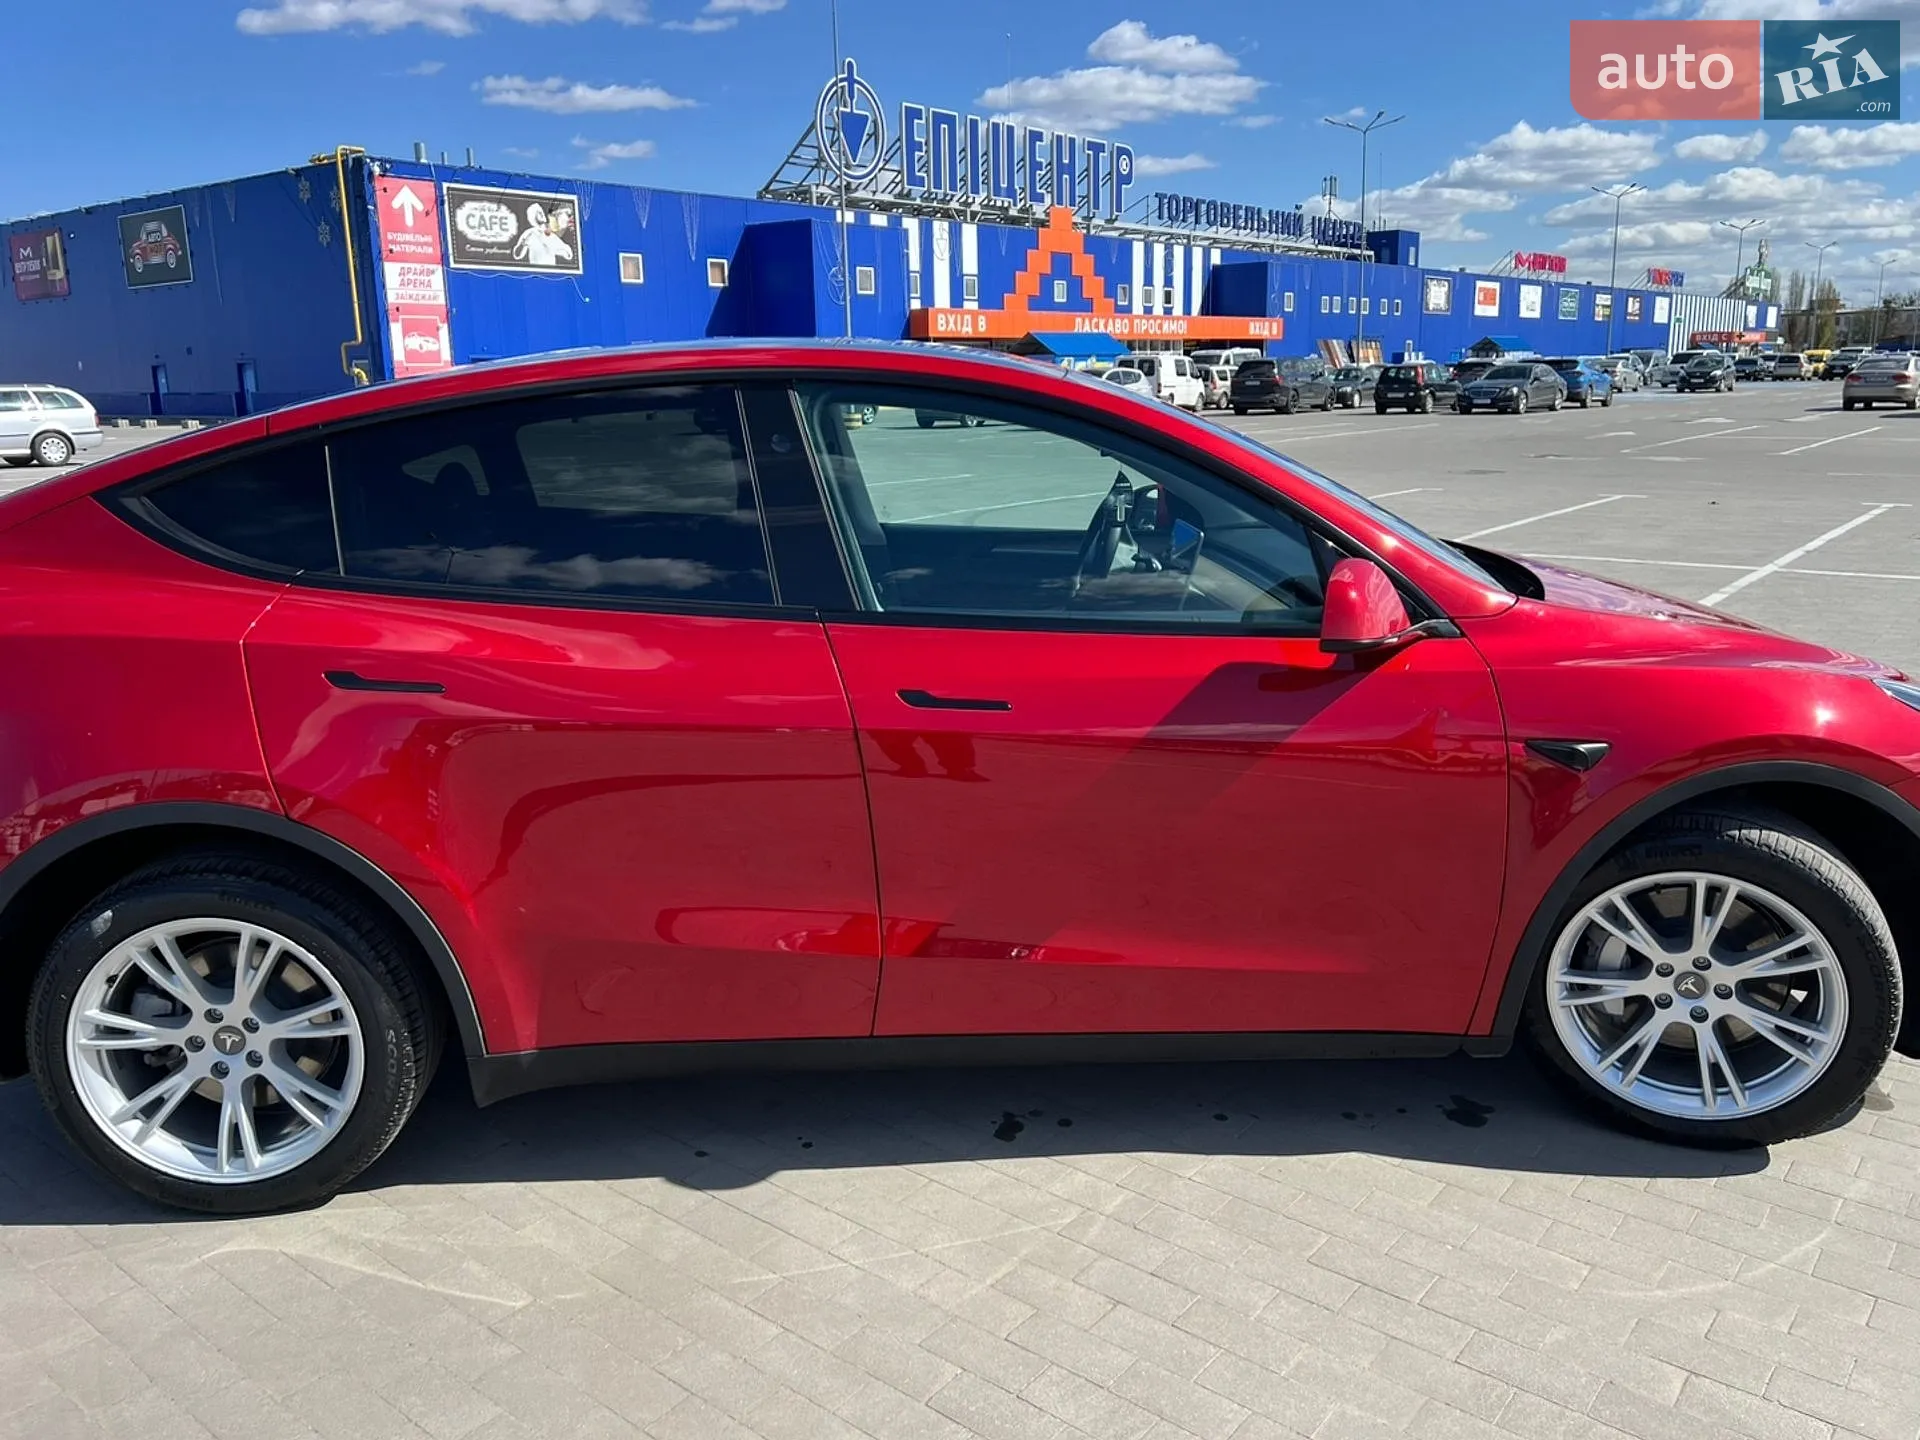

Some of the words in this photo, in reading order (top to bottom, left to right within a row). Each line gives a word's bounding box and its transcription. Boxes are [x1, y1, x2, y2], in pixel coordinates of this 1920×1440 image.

[900, 101, 1135, 214] ЕПІЦЕНТР
[466, 213, 509, 231] CAFE
[1155, 192, 1304, 237] ТОРГОВЕЛЬНИЙ
[398, 278, 432, 289] АРЕНА
[936, 313, 972, 333] ВХІД
[976, 315, 987, 331] В
[1073, 316, 1129, 334] ЛАСКАВО
[1132, 317, 1188, 335] ПРОСИМО!
[1248, 321, 1269, 336] ВХІД
